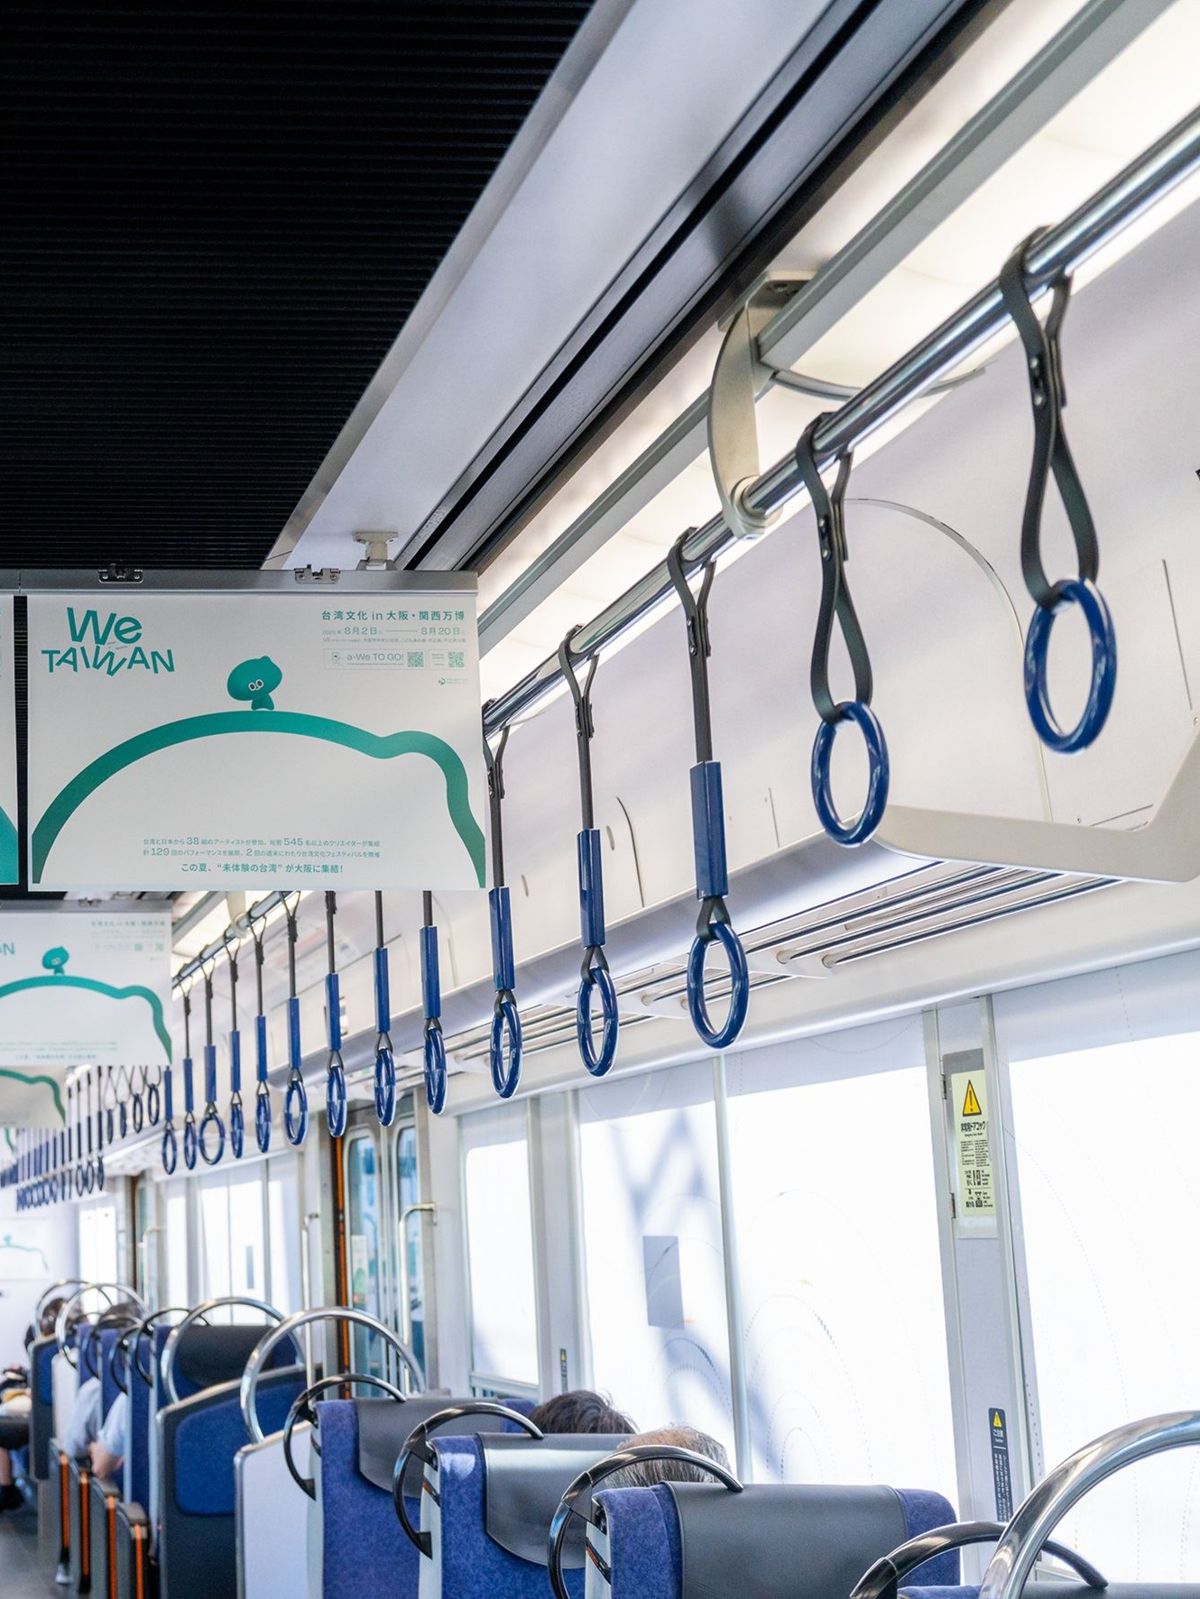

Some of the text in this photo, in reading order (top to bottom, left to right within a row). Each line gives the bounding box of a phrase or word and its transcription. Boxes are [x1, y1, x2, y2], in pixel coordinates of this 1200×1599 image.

[66, 607, 142, 645] We
[371, 611, 383, 621] in
[41, 646, 175, 677] TAIWAN
